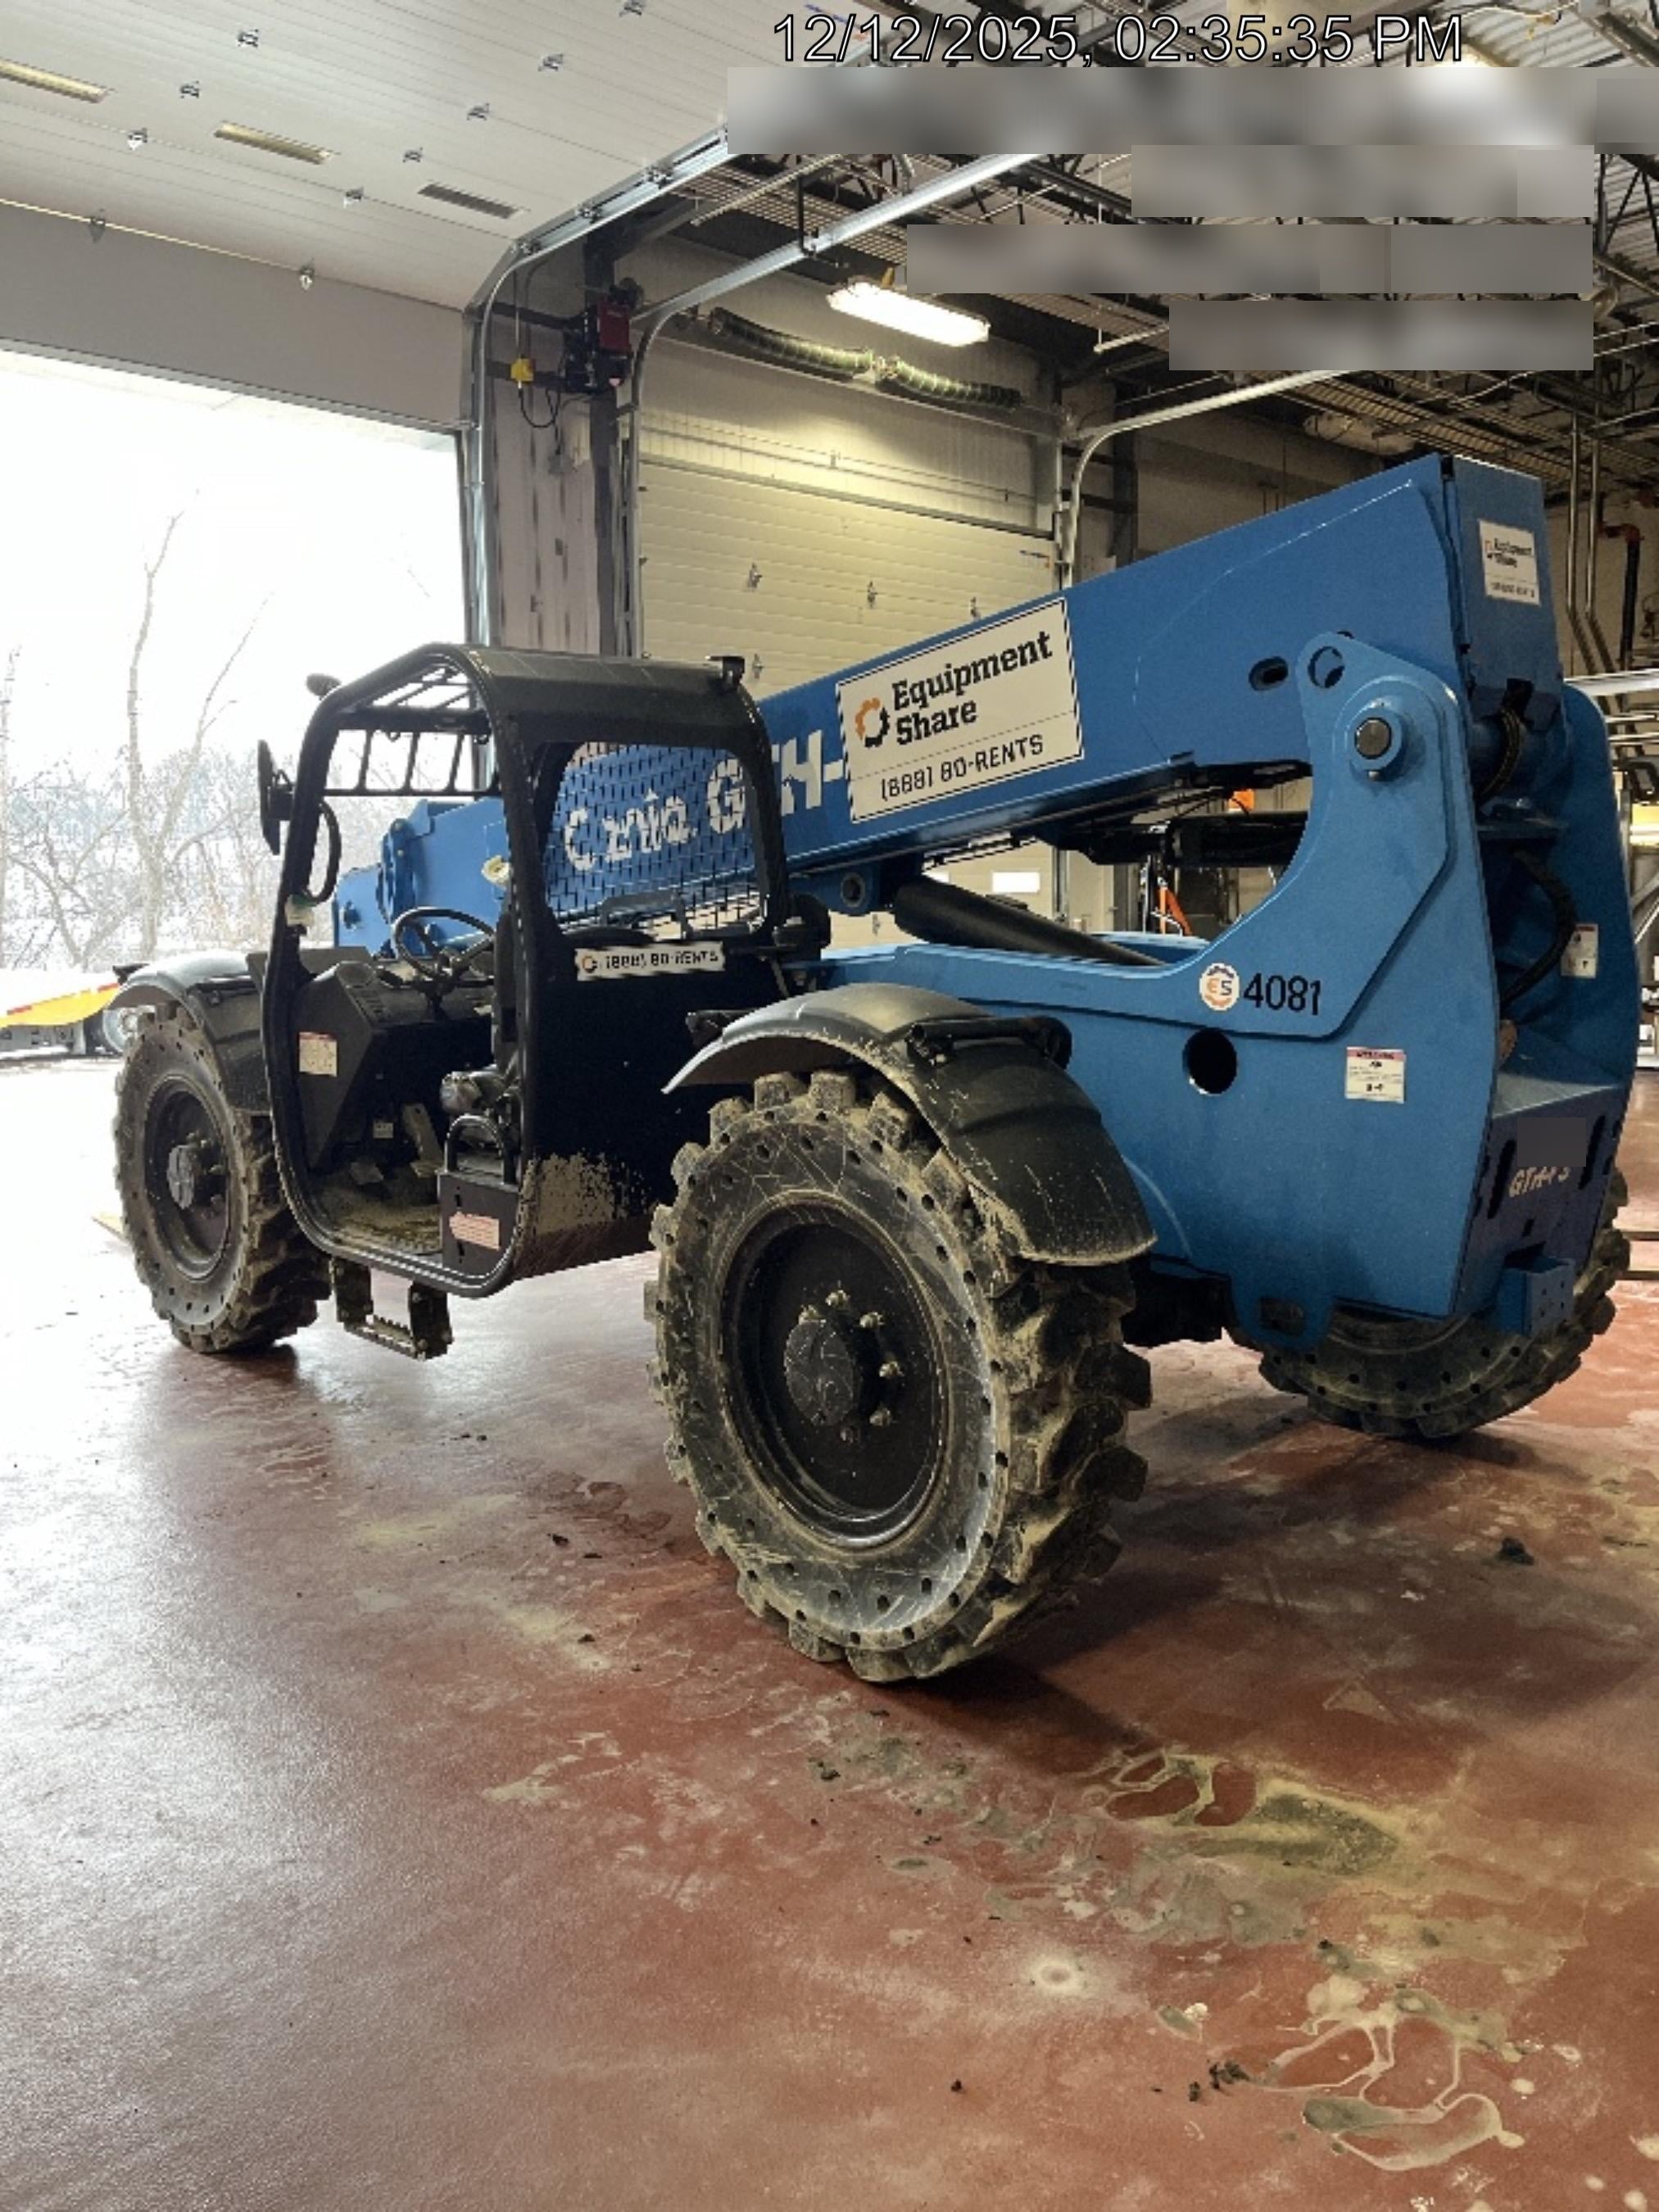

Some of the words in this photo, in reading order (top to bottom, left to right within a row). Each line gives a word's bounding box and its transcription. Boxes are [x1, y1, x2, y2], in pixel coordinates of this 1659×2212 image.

[892, 630, 1053, 710] Equipment
[896, 700, 979, 746] Share
[882, 765, 933, 802] (888)
[941, 733, 1044, 782] 80-RENTS
[1243, 972, 1321, 1016] 4081
